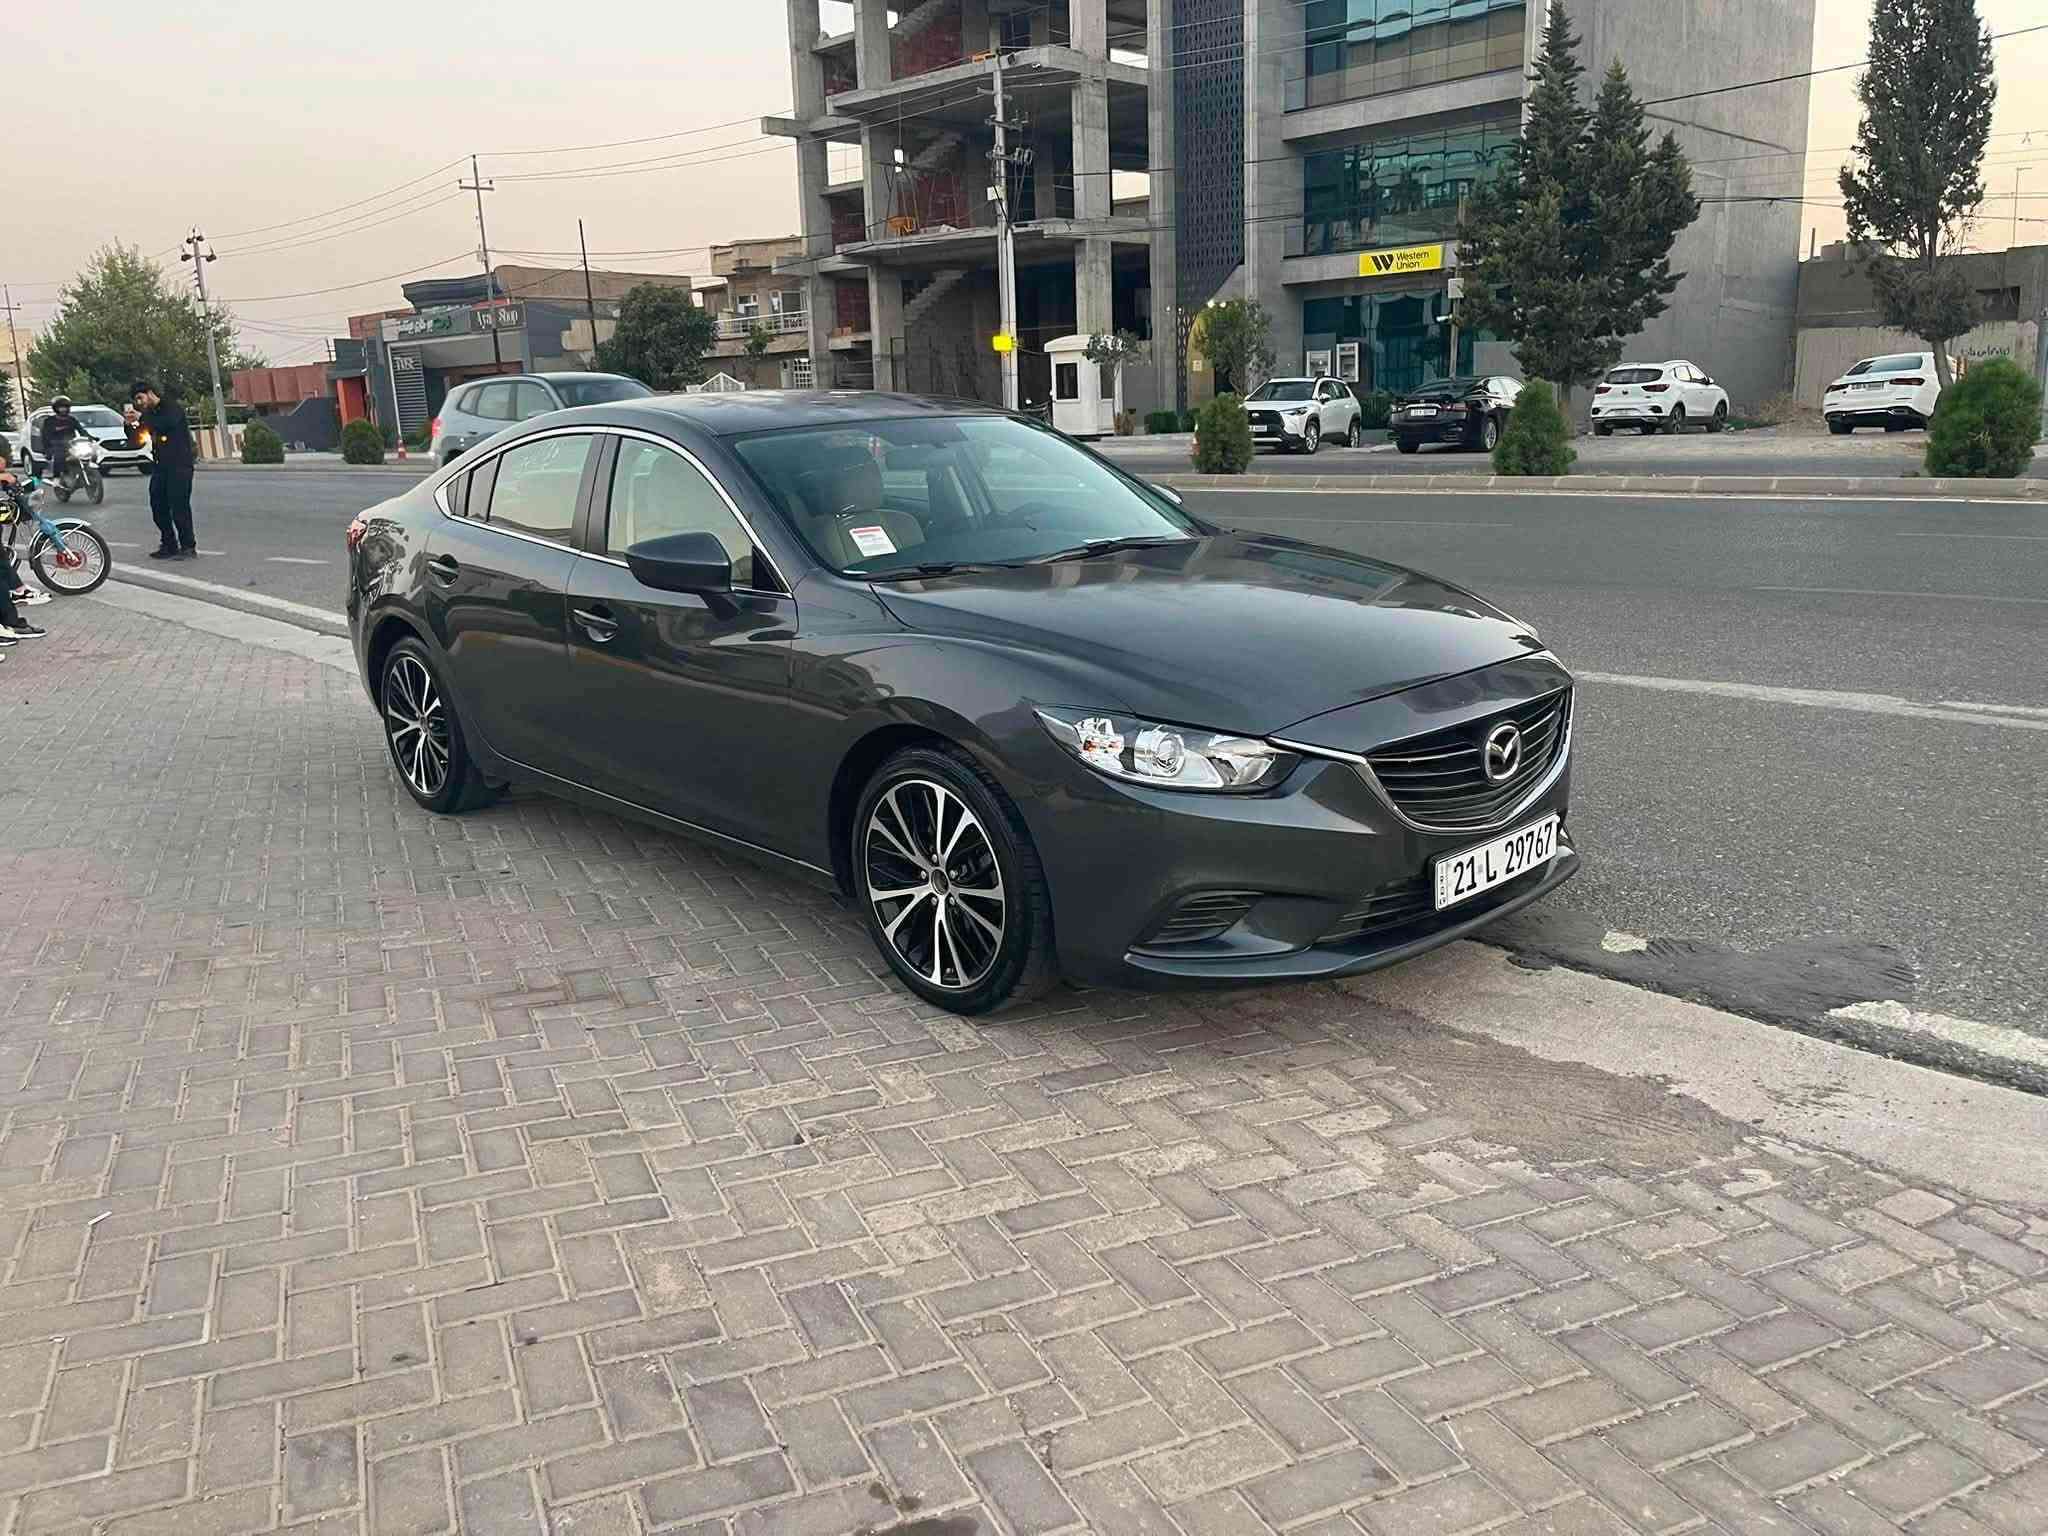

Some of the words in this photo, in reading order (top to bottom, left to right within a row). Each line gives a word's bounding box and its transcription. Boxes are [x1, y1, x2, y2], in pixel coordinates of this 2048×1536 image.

[1396, 251, 1430, 261] Western
[1396, 261, 1420, 270] Union
[1454, 856, 1477, 896] 21
[1485, 851, 1496, 882] L
[1505, 822, 1553, 875] 29767
